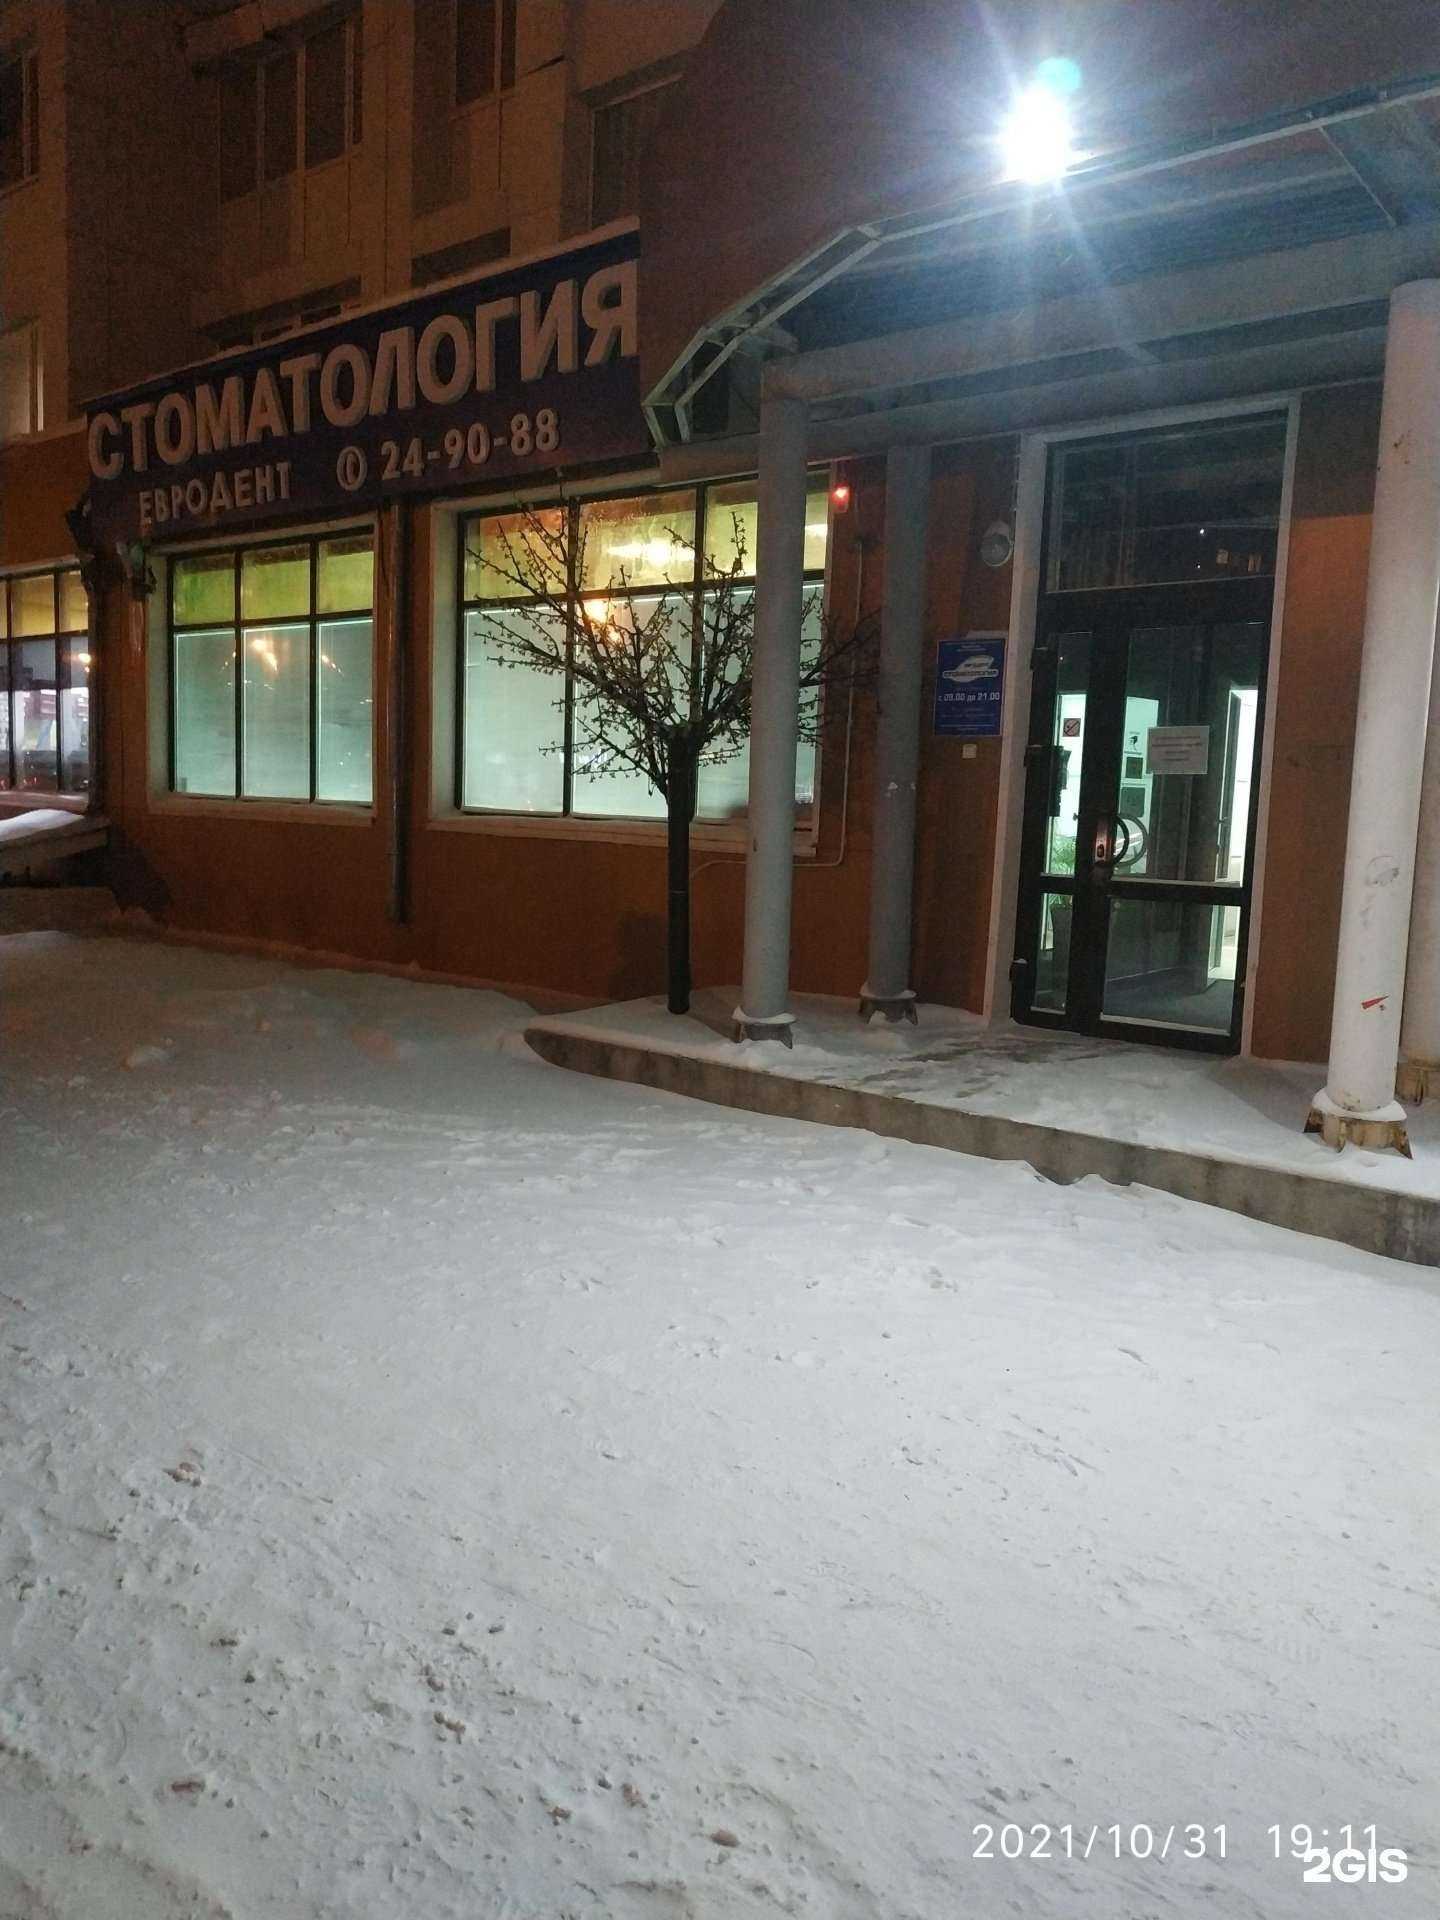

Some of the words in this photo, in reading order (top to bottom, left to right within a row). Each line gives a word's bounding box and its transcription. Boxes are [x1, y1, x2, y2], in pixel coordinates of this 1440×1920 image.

[87, 261, 639, 480] СТОМАТОЛОГИЯ
[381, 408, 559, 481] 24-90-88
[138, 461, 292, 526] ЕВРОДЕНТ
